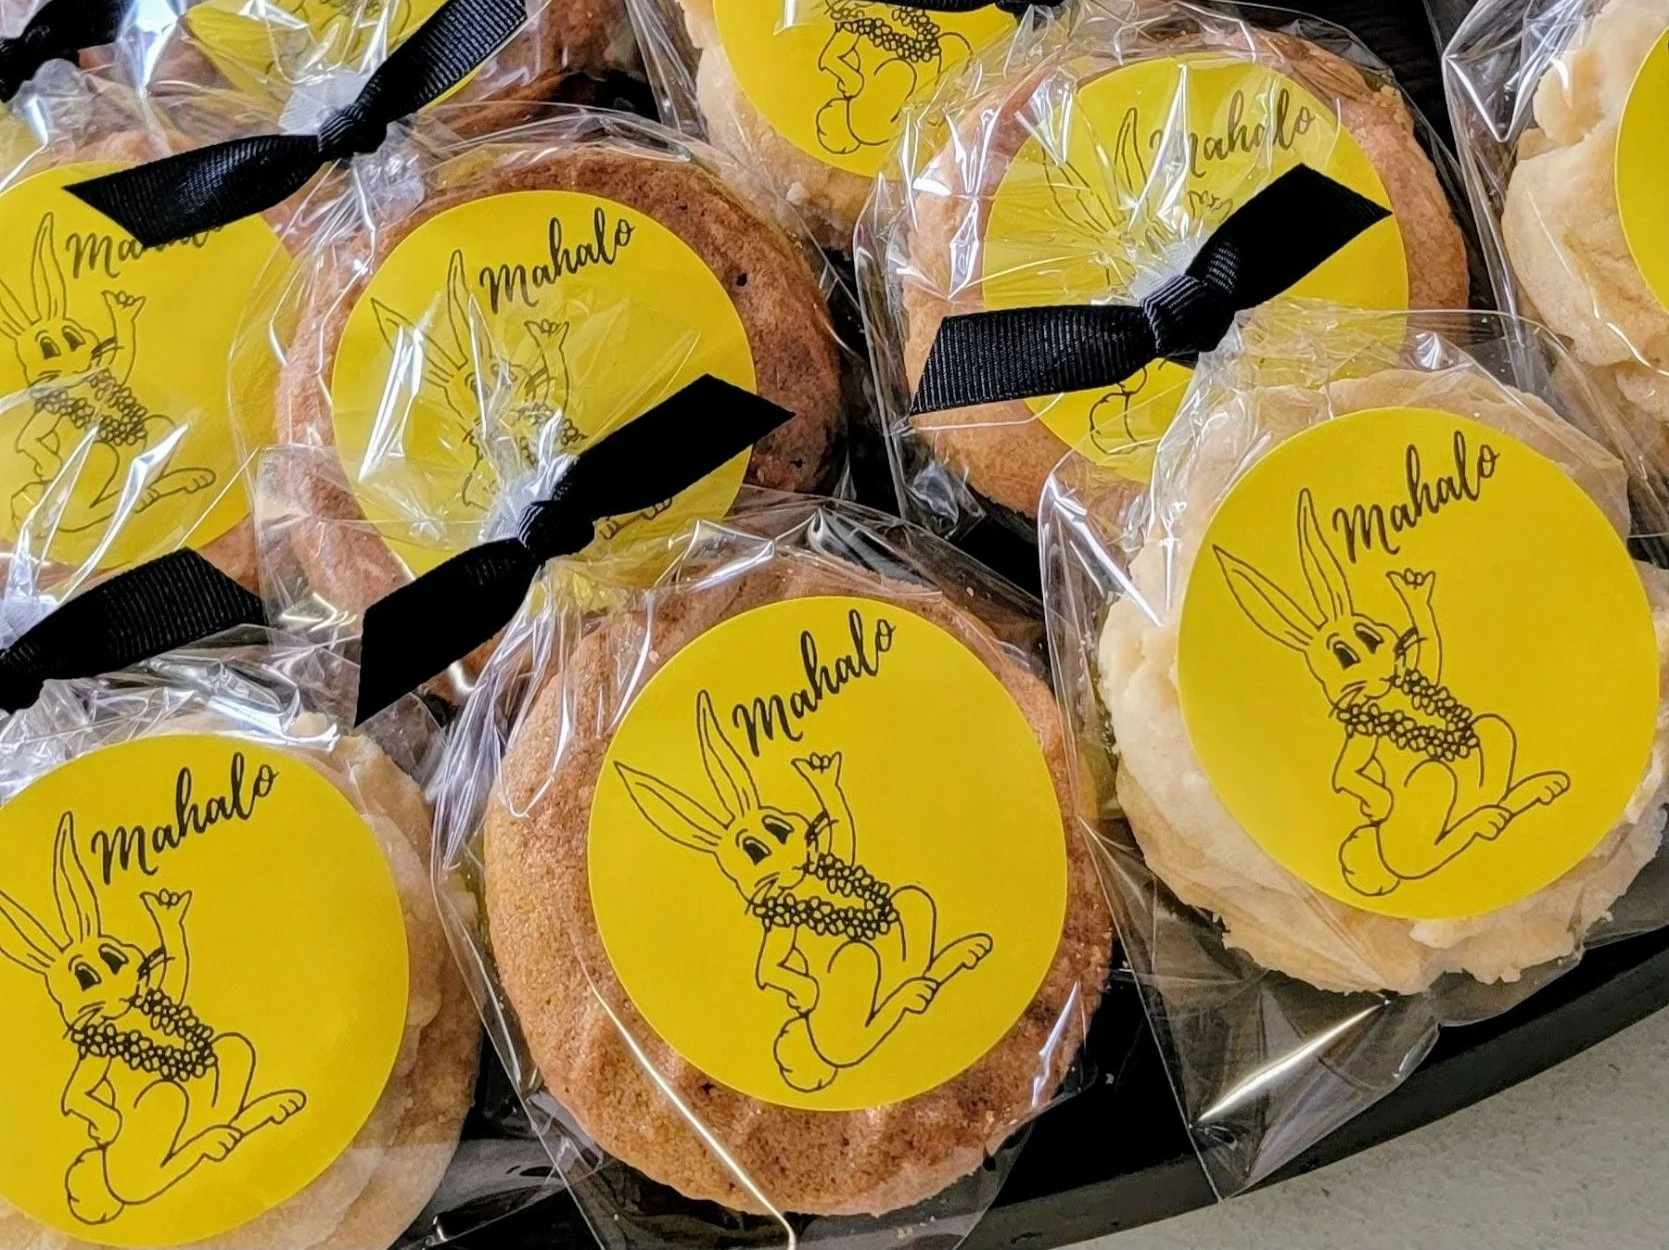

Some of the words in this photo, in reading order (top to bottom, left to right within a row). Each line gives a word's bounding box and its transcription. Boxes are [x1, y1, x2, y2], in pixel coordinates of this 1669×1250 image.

[479, 206, 636, 315] Mahalo
[1332, 429, 1501, 564] Mahalo
[732, 608, 897, 757] Mahalo
[90, 751, 280, 886] Mahalo
